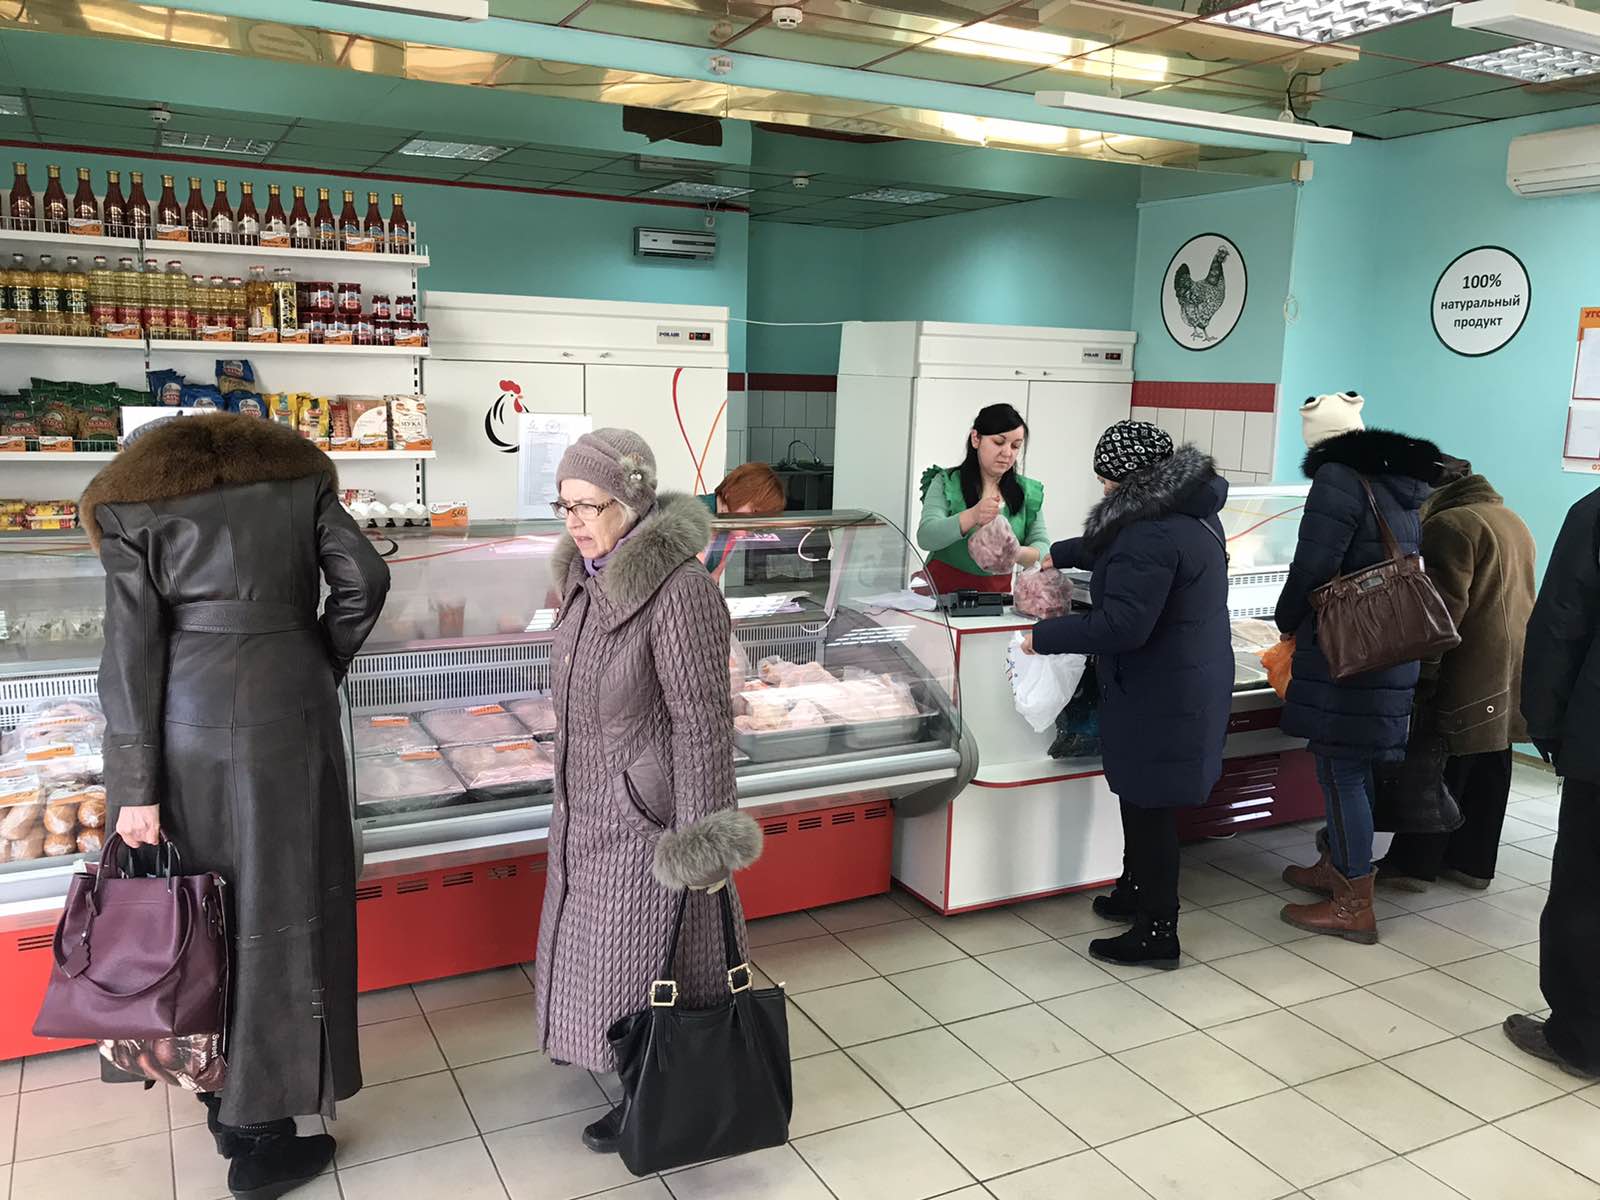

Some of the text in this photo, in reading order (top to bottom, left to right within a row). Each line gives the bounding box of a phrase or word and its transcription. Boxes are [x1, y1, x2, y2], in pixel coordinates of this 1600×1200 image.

[1462, 273, 1502, 289] 100%
[1441, 294, 1521, 311] натуральный
[1453, 317, 1503, 330] продукт
[211, 1033, 220, 1059] Sweet
